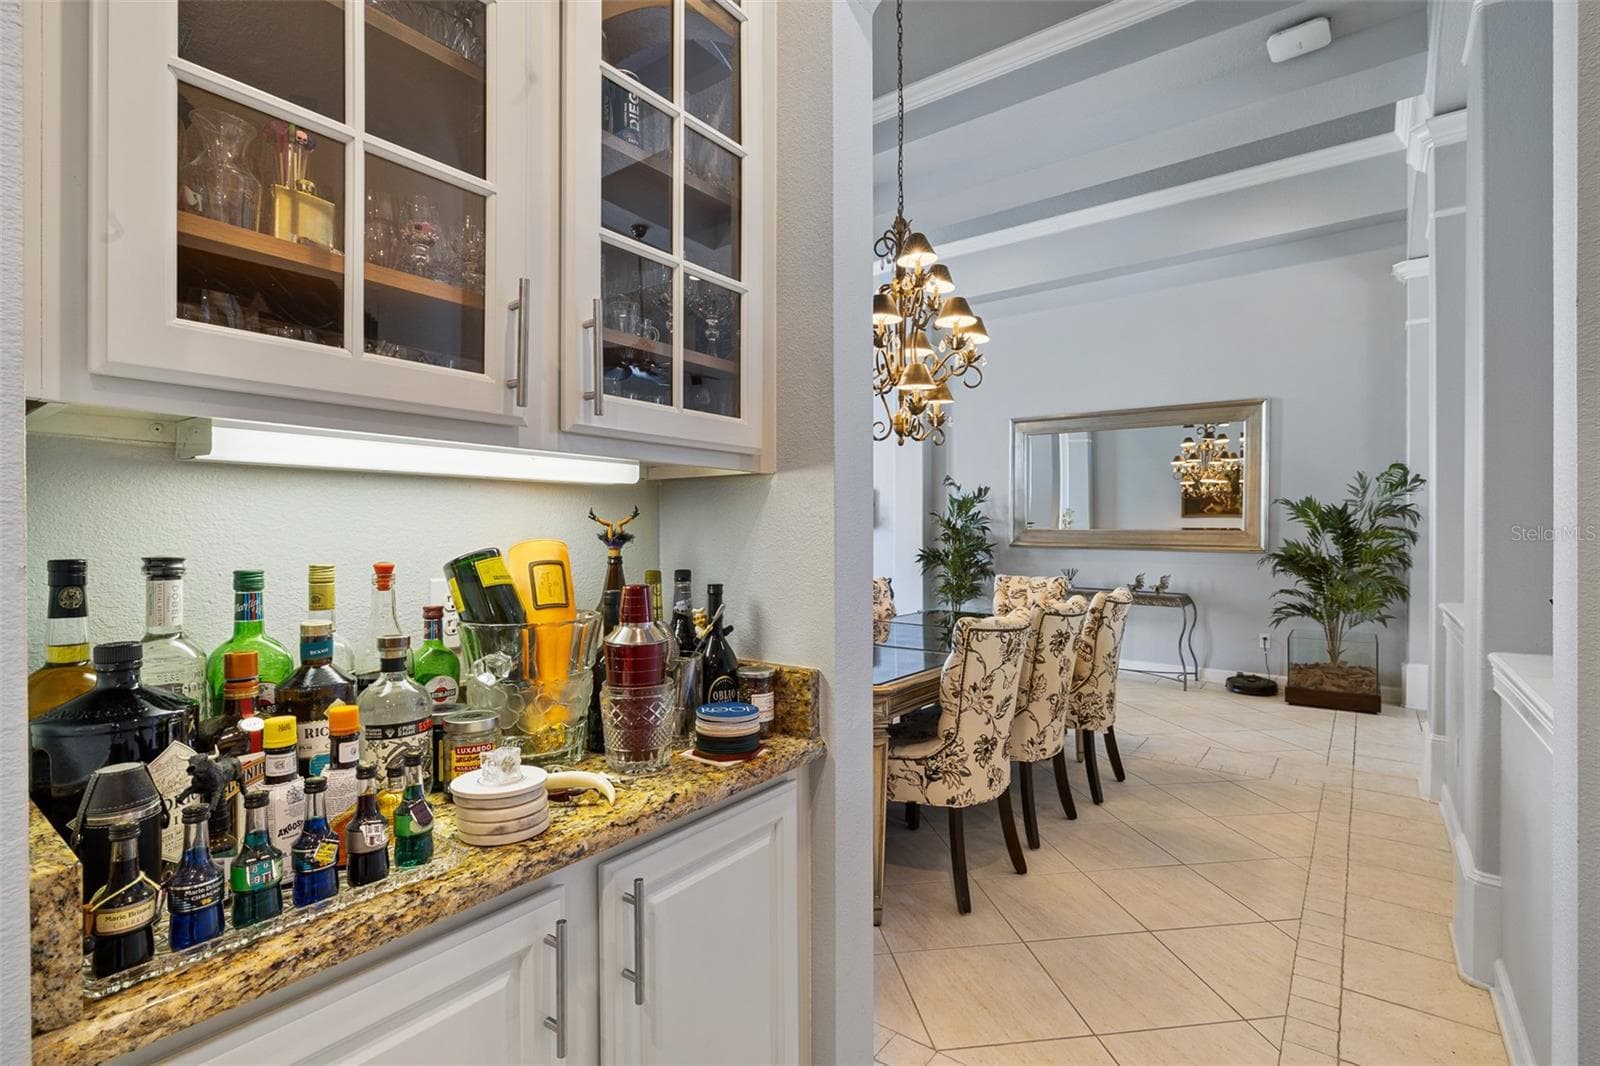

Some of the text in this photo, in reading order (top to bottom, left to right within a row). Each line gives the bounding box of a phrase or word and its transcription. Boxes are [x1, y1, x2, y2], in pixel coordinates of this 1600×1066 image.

[628, 92, 640, 132] DIEG
[171, 584, 179, 623] DOBEL
[304, 726, 329, 739] RIC
[456, 744, 492, 754] LUXARDO
[105, 914, 127, 922] Marie
